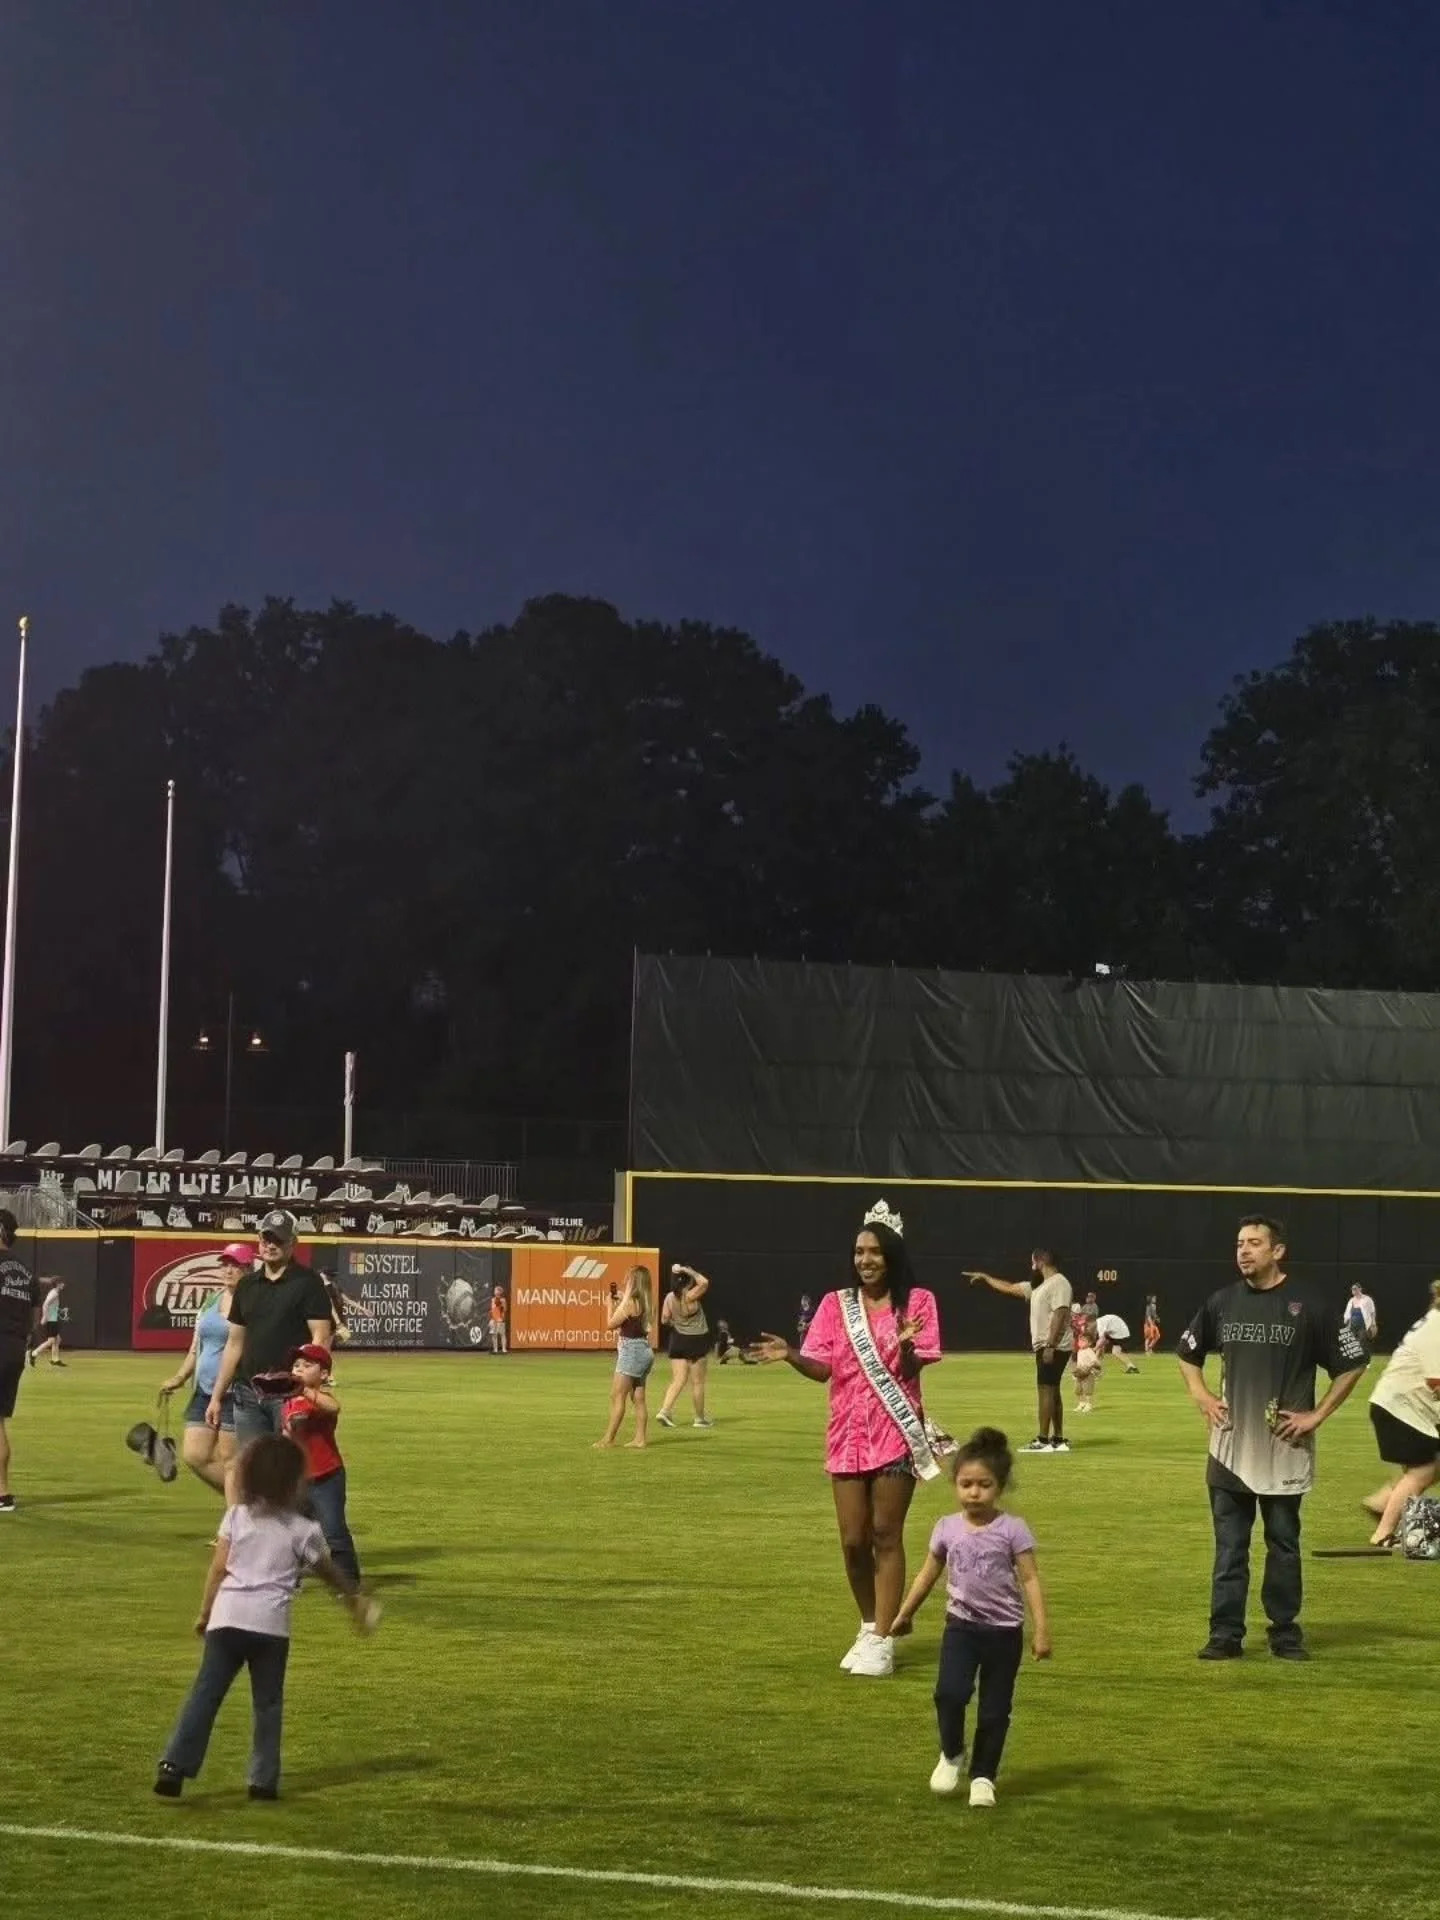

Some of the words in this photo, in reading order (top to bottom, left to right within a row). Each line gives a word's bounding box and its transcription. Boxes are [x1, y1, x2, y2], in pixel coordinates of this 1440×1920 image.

[97, 1169, 171, 1193] MILER
[179, 1173, 221, 1194] LITE
[340, 1217, 357, 1228] TIME
[564, 1217, 584, 1227] LIKE
[365, 1254, 420, 1275] SYSTEL
[1097, 1270, 1117, 1281] 400
[361, 1283, 410, 1299] ALL-STAR
[516, 1288, 625, 1306] MANNACHU
[342, 1300, 403, 1316] SOLUTIONS
[405, 1301, 428, 1316] FOR
[347, 1318, 382, 1333] EVERY
[384, 1318, 423, 1333] OFFICE
[1269, 1324, 1296, 1346] IV
[874, 1369, 916, 1430] CAROLINA
